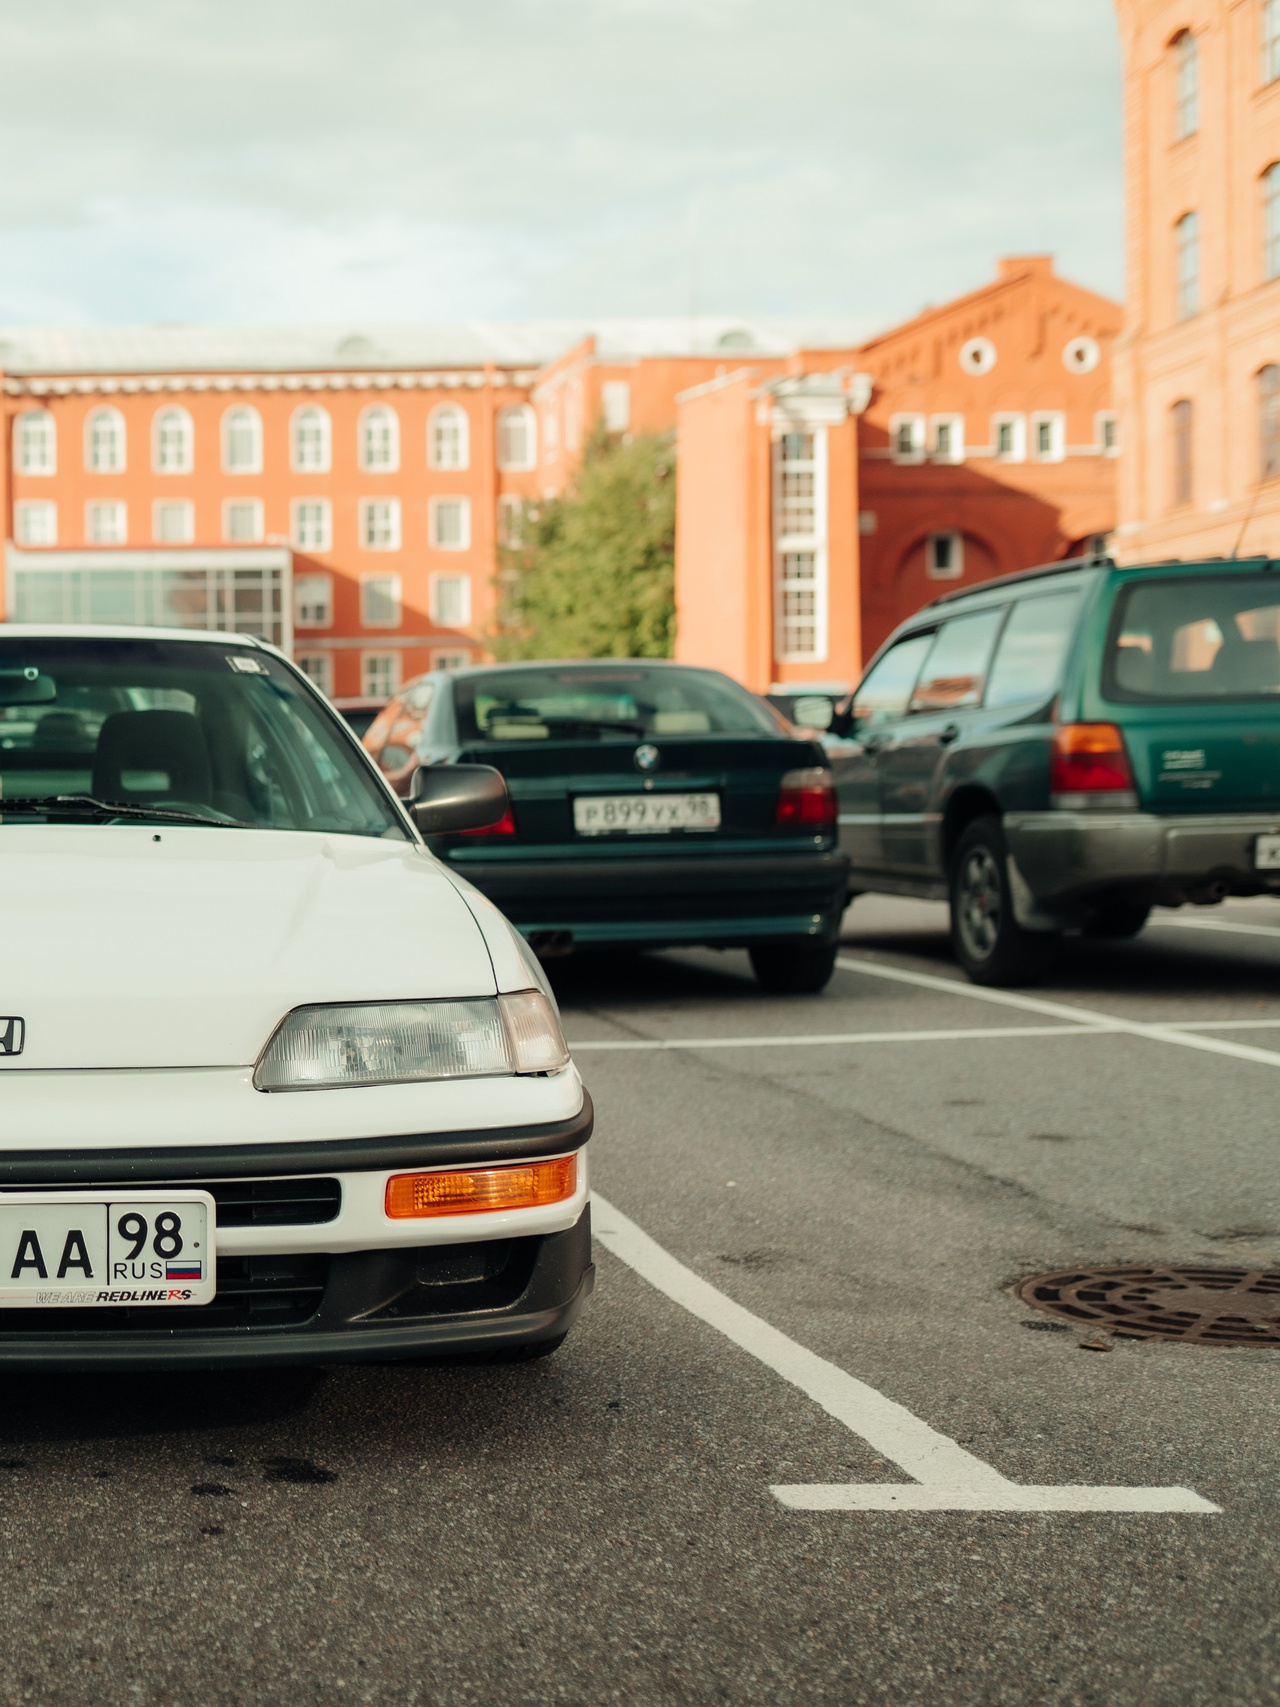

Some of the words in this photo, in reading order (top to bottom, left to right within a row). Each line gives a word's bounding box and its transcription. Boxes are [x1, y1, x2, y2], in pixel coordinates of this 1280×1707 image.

[117, 1211, 184, 1260] 98
[113, 1262, 163, 1280] RUS
[36, 1292, 61, 1304] WE
[60, 1291, 96, 1303] ARE
[96, 1289, 193, 1302] REDLINERS
